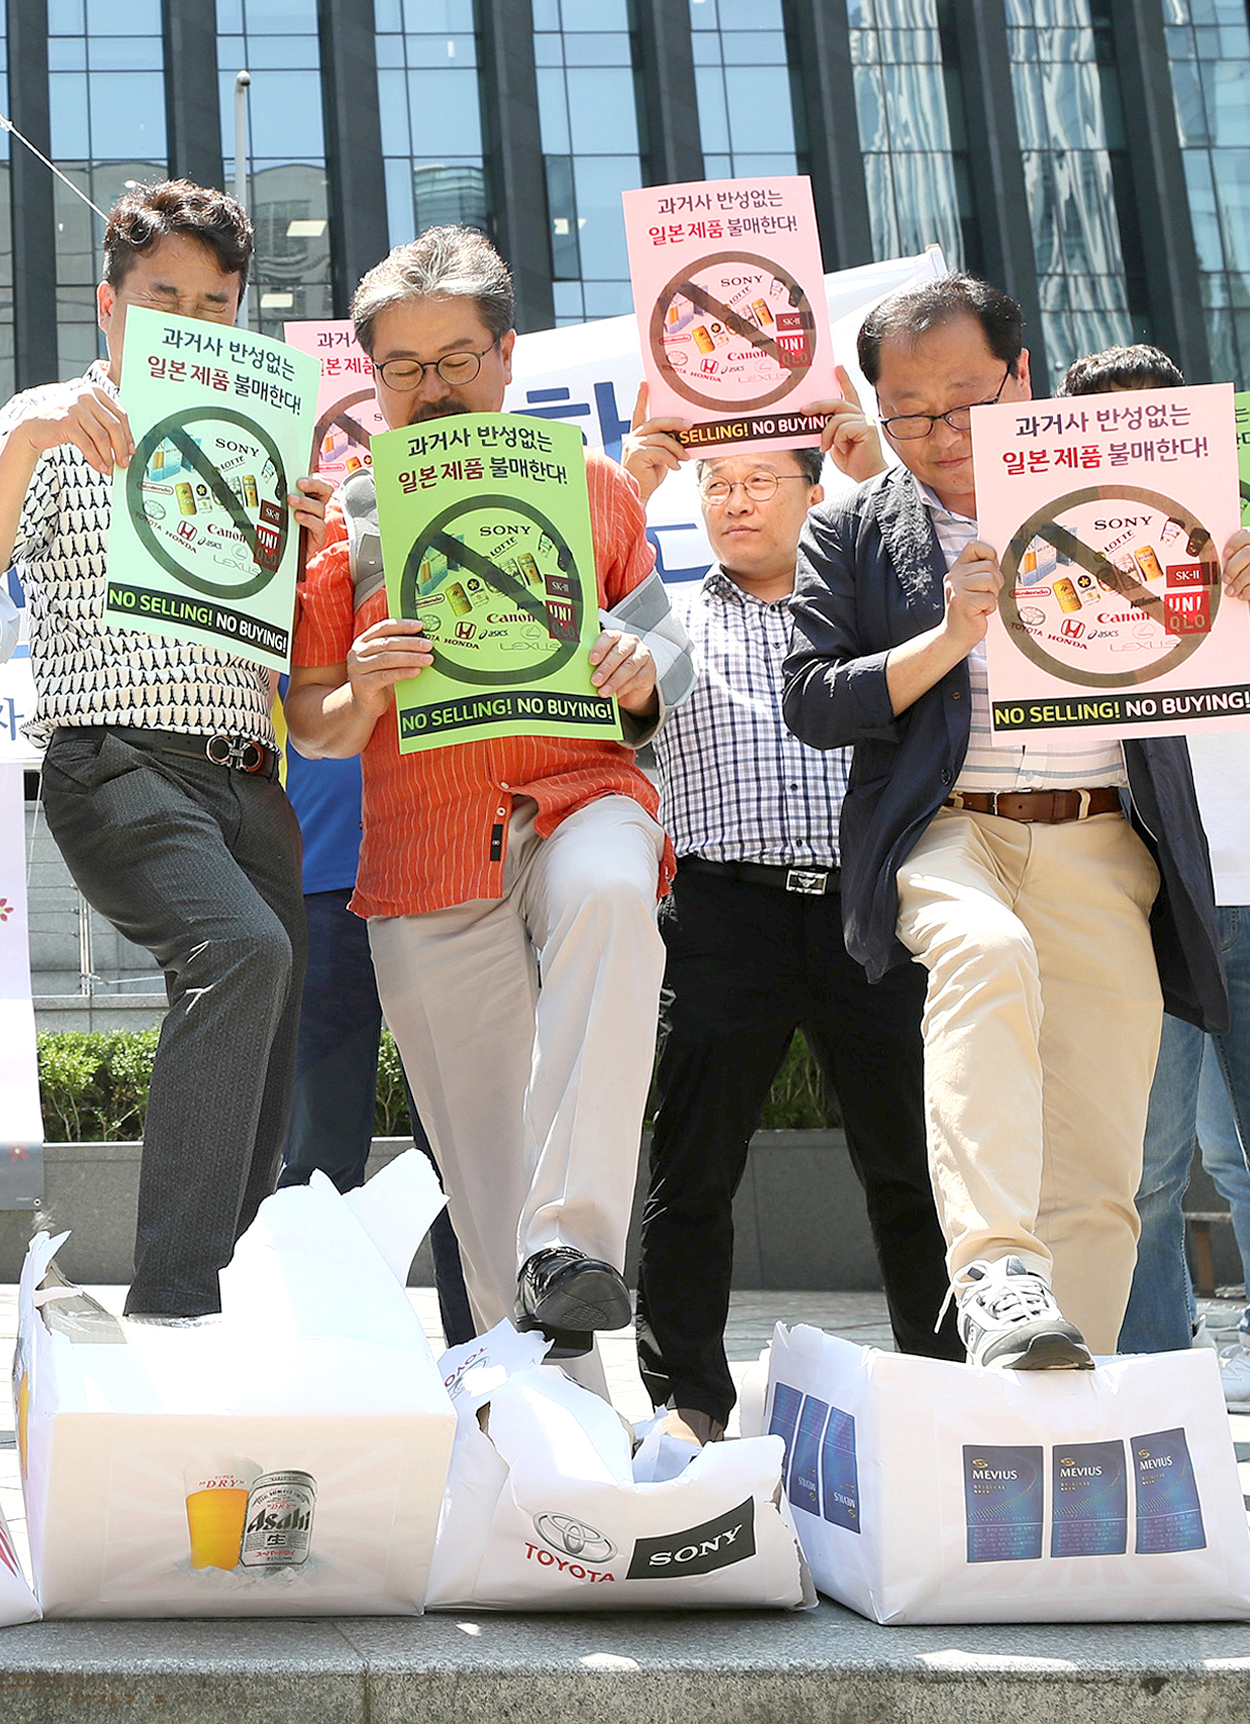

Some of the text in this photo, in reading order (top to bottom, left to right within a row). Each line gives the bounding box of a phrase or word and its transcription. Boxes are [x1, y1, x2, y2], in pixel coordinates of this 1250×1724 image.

[657, 189, 783, 215] 과거사 반성없는
[649, 216, 798, 246] 일본 제품 불매한다!
[721, 275, 763, 287] SONY
[780, 338, 803, 350] UNI
[162, 328, 295, 381] 과거사 반성없는
[727, 351, 767, 361] Canon
[147, 356, 301, 415] 일본 제품 불매한다!
[690, 372, 721, 382] HONDA
[1015, 404, 1191, 437] 과거사 반성없는
[408, 426, 552, 457] 과거사 반성없는
[679, 423, 749, 444] SELLING!
[752, 421, 775, 435] NO
[215, 438, 259, 457] SONY
[1002, 437, 1209, 476] 일본 제품 불매한다!
[221, 456, 244, 469] LOTTE
[398, 457, 568, 494] 일본 제품 불매한다!
[480, 525, 531, 536] SONY
[1094, 516, 1153, 530] SONY
[165, 531, 197, 553] HONDA
[207, 524, 246, 543] Canon
[258, 530, 277, 549] UNI
[1104, 530, 1134, 552] LOTTE
[490, 537, 516, 556] LOTTE
[213, 555, 260, 575] LEXUS
[1176, 571, 1199, 580] SK-II
[550, 605, 571, 621] UNI
[1169, 596, 1201, 612] UNI
[109, 589, 287, 652] NO SELLING! NO BUYING!
[487, 613, 535, 623] Canon
[1097, 612, 1150, 624] Canon
[1171, 614, 1205, 632] QLO
[1012, 622, 1043, 636] TOYOTA
[444, 638, 479, 649] HONDA
[500, 642, 559, 651] LEXUS
[1048, 634, 1087, 650] HONDA
[1110, 639, 1178, 652] LEXUS
[402, 698, 612, 732] NO SELLING! NO BUYING!
[995, 690, 1250, 725] NO SELLING! NO BUYING!
[1060, 1466, 1102, 1477] MEVIUS
[1140, 1456, 1173, 1471] MEVIUS
[973, 1470, 1018, 1480] MEVIUS
[247, 1508, 310, 1533] Asahi
[267, 1535, 285, 1545] 生
[649, 1524, 742, 1567] SONY
[524, 1542, 616, 1583] TOYOTA
